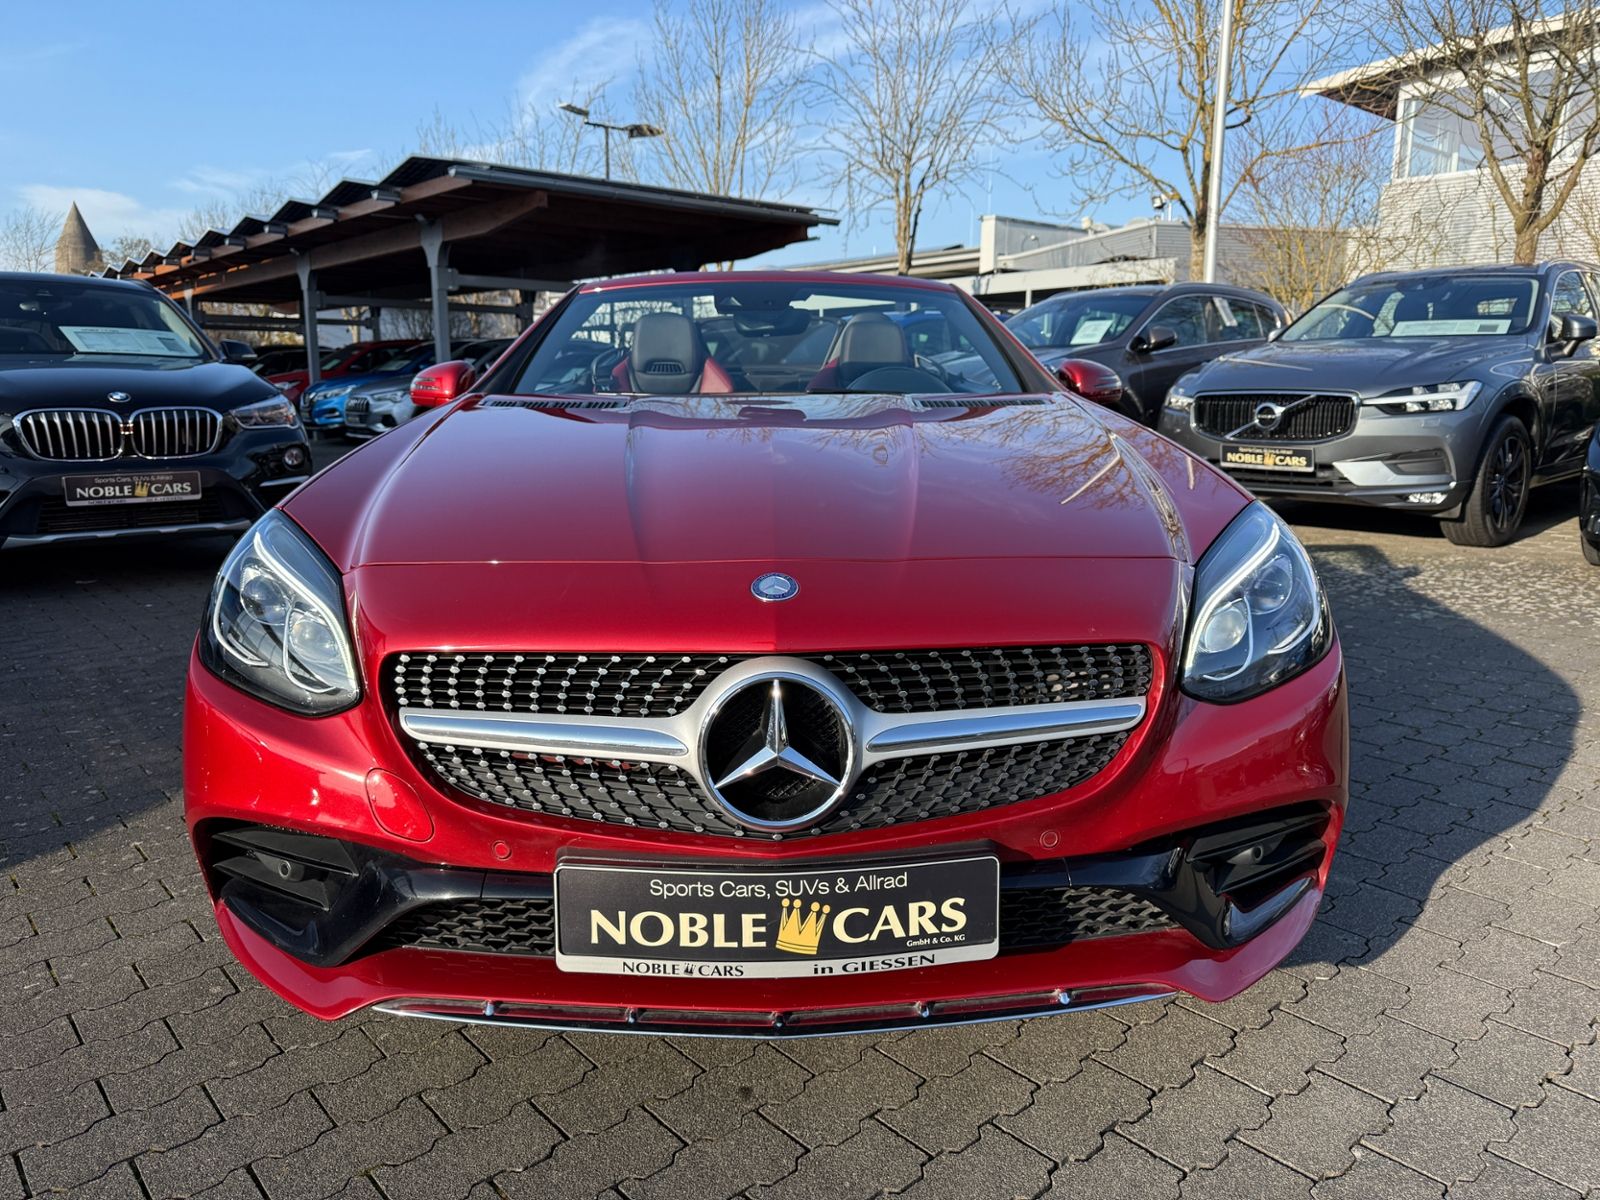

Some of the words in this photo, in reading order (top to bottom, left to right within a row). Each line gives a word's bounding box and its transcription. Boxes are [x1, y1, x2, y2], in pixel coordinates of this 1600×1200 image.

[1227, 452, 1264, 465] NOBLE
[1275, 456, 1307, 467] CARS
[76, 485, 132, 498] NOBLE
[151, 482, 192, 494] CARS
[650, 879, 714, 899] Sports
[719, 881, 770, 899] Cars,
[775, 879, 829, 896] SUVs
[835, 879, 850, 893] &
[854, 872, 907, 892] Allrad
[590, 909, 767, 948] NOBLE
[832, 897, 967, 943] CARS
[906, 937, 931, 947] GmbH
[940, 935, 953, 944] Co.
[954, 934, 966, 942] KG
[622, 961, 680, 975] NOBLE
[698, 964, 744, 976] CARS
[813, 964, 834, 974] in
[842, 954, 936, 973] GIESSEN
